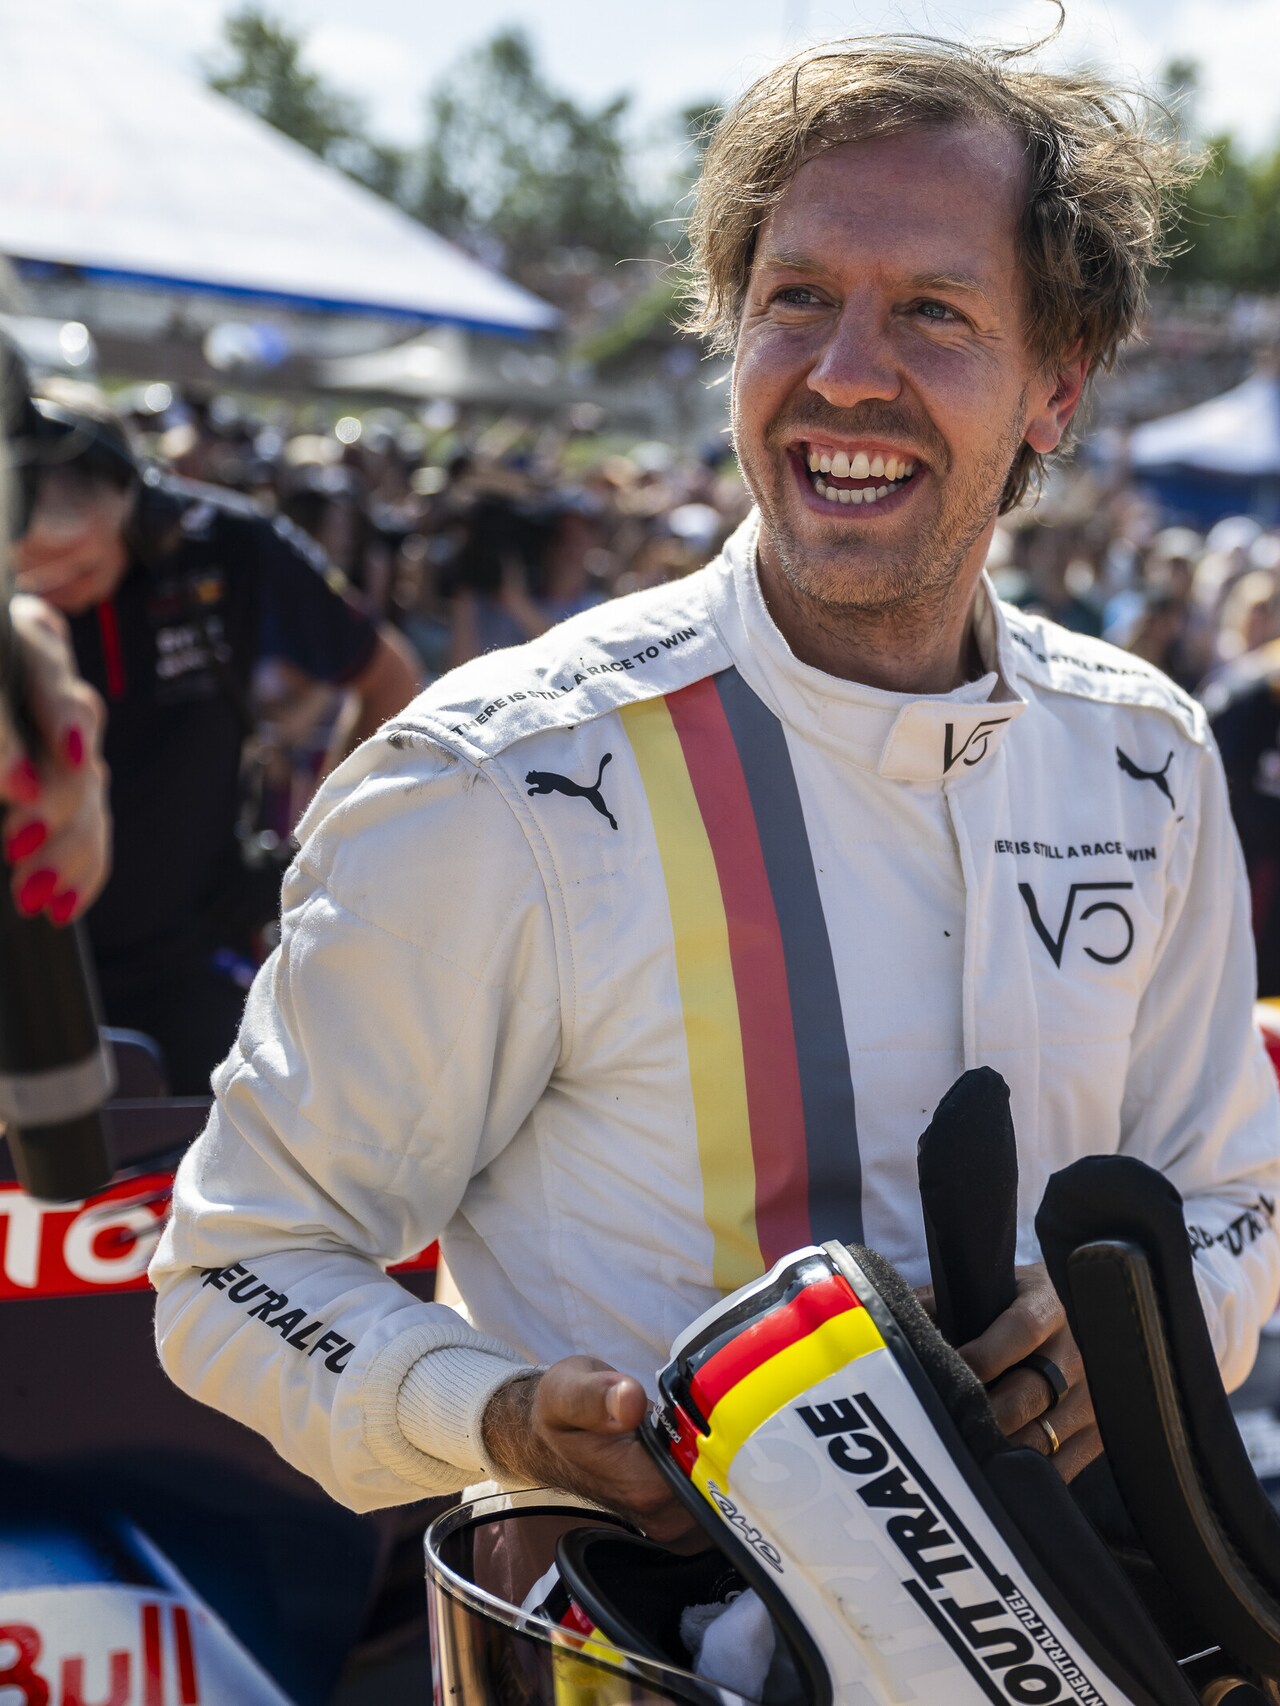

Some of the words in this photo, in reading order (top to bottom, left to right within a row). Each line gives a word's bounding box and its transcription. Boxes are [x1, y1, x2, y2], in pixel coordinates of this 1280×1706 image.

[451, 698, 507, 736] THERE
[507, 690, 527, 703] IS
[528, 685, 574, 701] STILL
[573, 672, 588, 686] A
[586, 659, 635, 677] RACE
[633, 645, 660, 664] TO
[659, 627, 698, 650] WIN
[1015, 841, 1030, 854] IS
[1033, 842, 1064, 859] STILL
[1067, 846, 1080, 858] A
[1081, 842, 1123, 856] RACE
[1125, 847, 1157, 862] WIN
[795, 1397, 973, 1591] TRACE
[1005, 1589, 1043, 1630] FUEL
[1035, 1628, 1094, 1698] NEUTRAL
